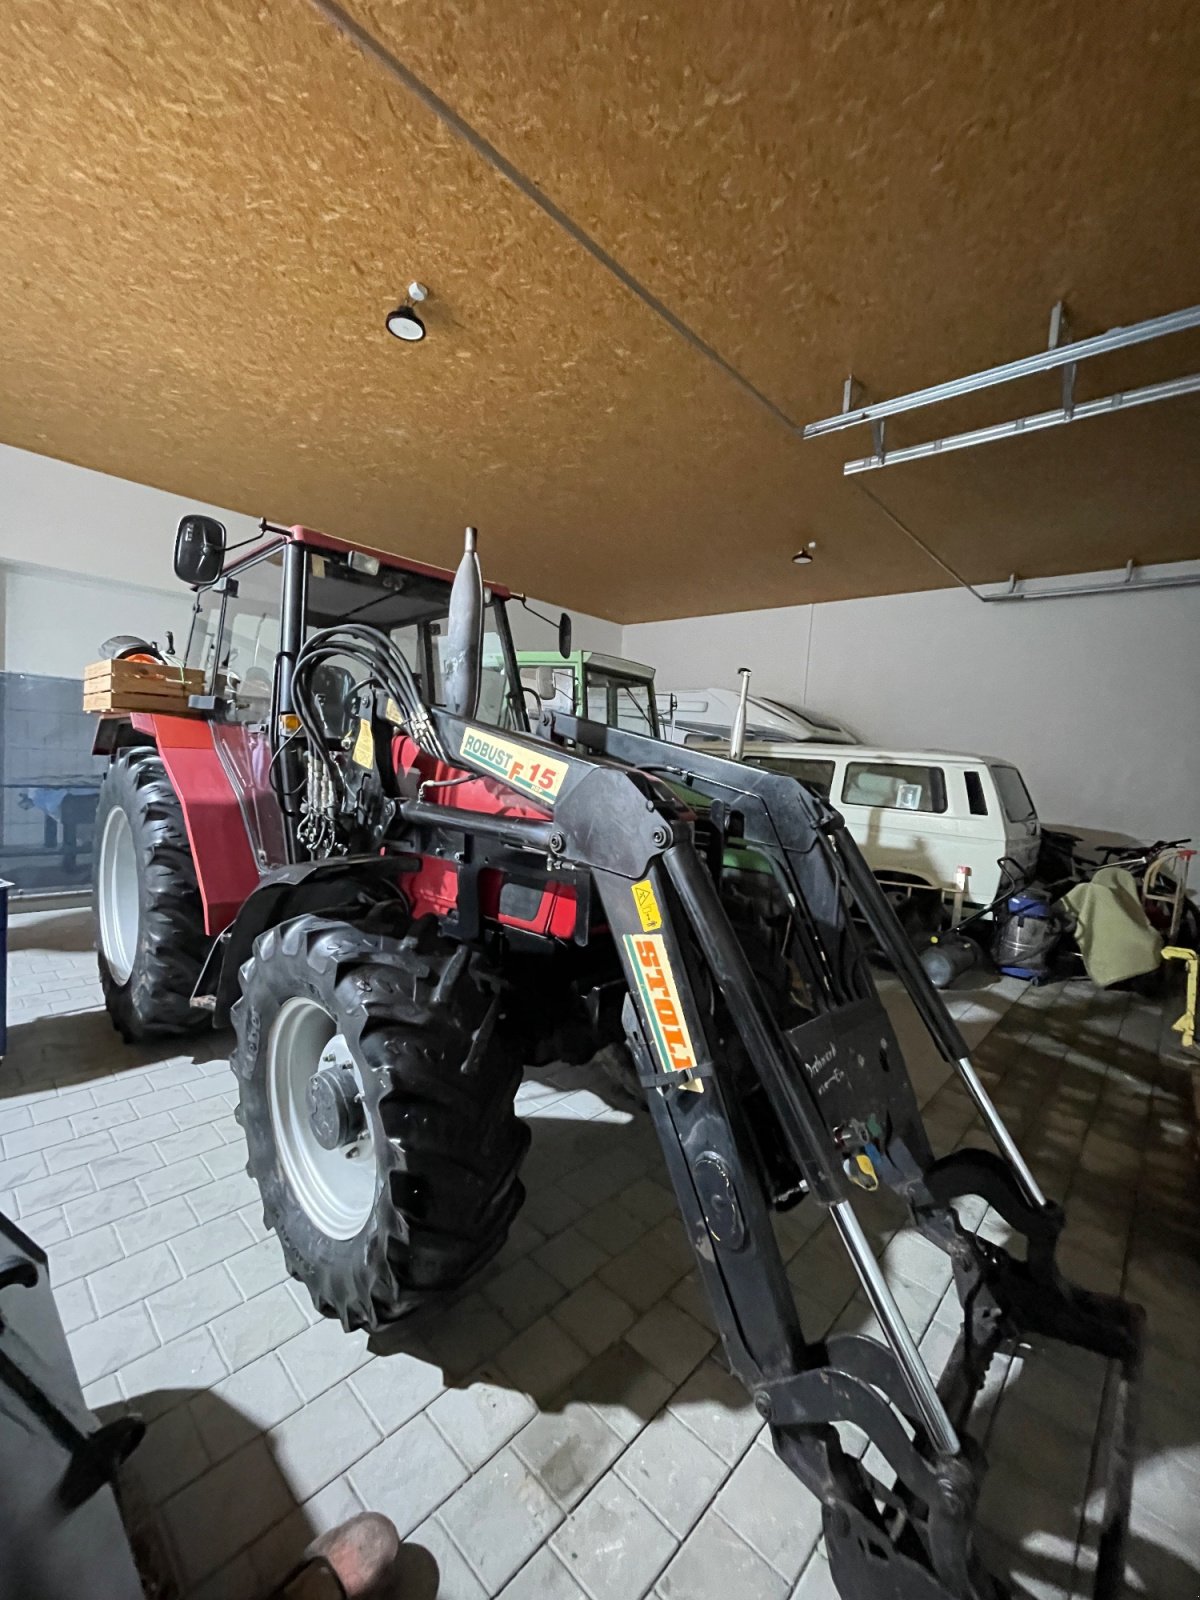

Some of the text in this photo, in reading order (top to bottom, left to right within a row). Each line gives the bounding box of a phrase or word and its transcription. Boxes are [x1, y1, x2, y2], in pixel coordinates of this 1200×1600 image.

[464, 734, 557, 790] ROBUST F 15
